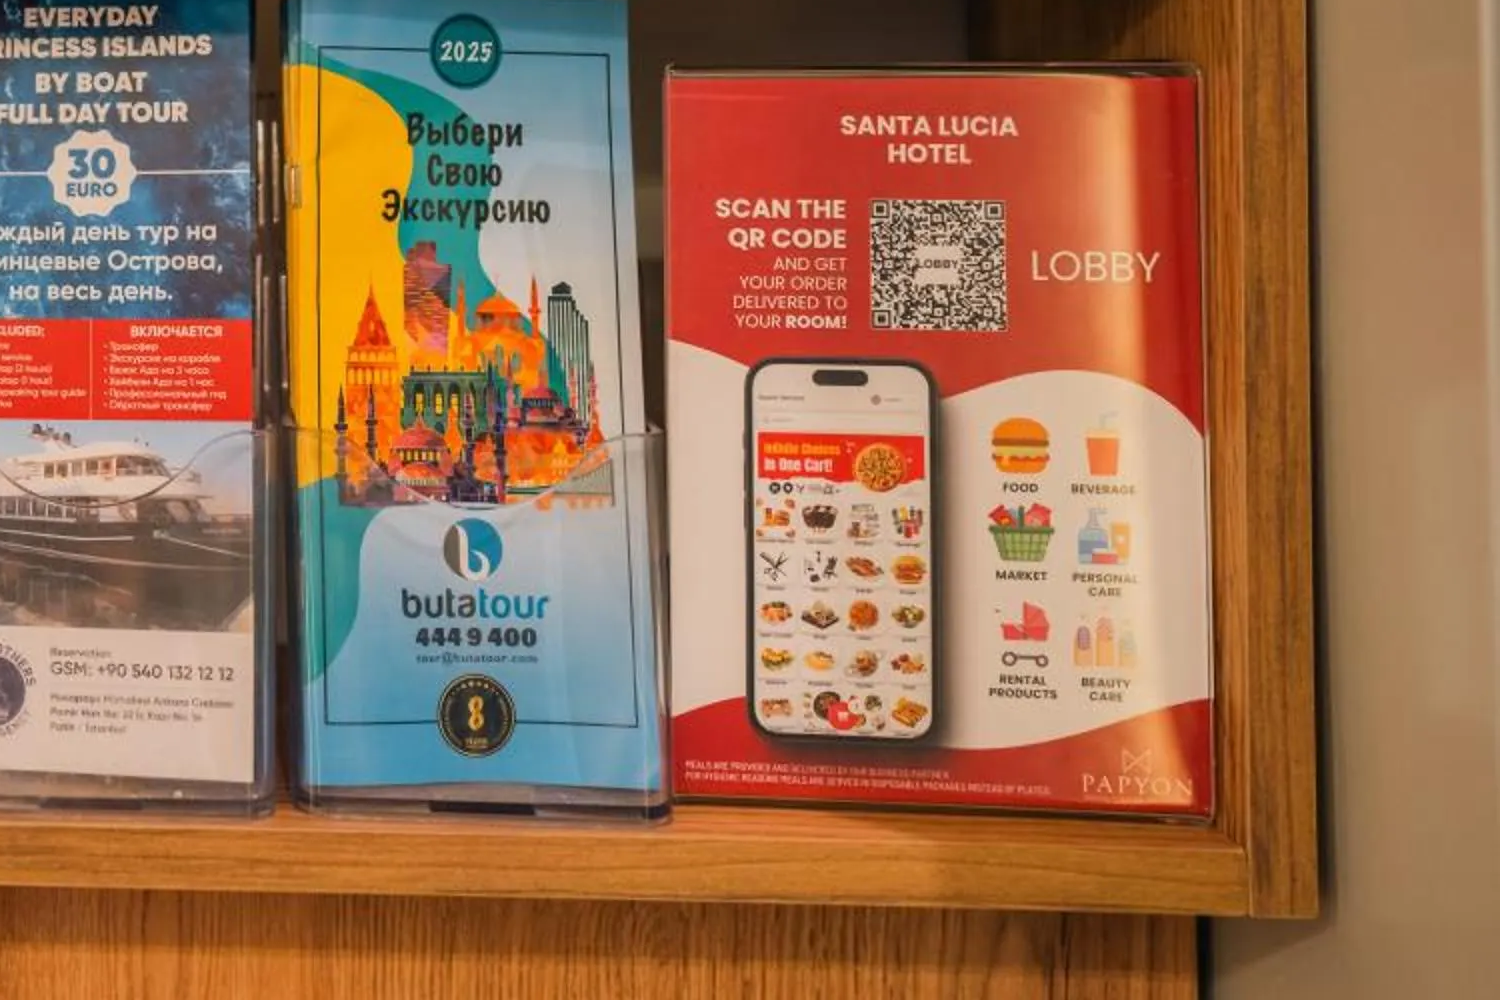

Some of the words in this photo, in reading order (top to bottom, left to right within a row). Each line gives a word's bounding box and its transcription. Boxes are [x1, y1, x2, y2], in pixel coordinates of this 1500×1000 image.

[23, 5, 158, 28] EVERYDAY
[102, 35, 213, 57] ISLANDS
[440, 41, 493, 63] 2025
[35, 72, 66, 94] BY
[77, 72, 148, 93] BOAT
[58, 103, 109, 124] DAY
[116, 101, 189, 123] TOUR
[407, 112, 524, 153] Выбери
[840, 115, 932, 137] SANTA
[938, 115, 1019, 138] LUCIA
[67, 147, 117, 180] 30
[887, 143, 972, 165] HOTEL
[426, 154, 502, 187] Свою
[66, 183, 118, 197] EURO
[381, 188, 551, 230] Экскурсию
[715, 198, 791, 220] SCAN
[797, 198, 847, 220] THE
[72, 225, 131, 244] день
[138, 224, 180, 245] тур
[186, 223, 218, 240] на
[727, 228, 766, 250] QR
[771, 228, 847, 250] CODE
[108, 251, 224, 276] Острова,
[774, 258, 810, 272] AND
[815, 258, 847, 272] GET
[1030, 251, 1161, 283] LOBBY
[9, 287, 39, 301] на
[47, 285, 102, 301] весь
[108, 284, 173, 303] день.
[739, 276, 786, 290] YOUR
[790, 276, 848, 291] ORDER
[733, 295, 819, 309] DELIVERED
[824, 296, 847, 310] TO
[130, 325, 224, 338] ВКЛЮЧАЕТСЯ
[735, 314, 781, 329] YOUR
[785, 315, 848, 329] ROOM!
[1003, 483, 1039, 494] FOOD
[1071, 484, 1136, 495] BEVERAGE
[995, 570, 1048, 581] MARKET
[1072, 573, 1137, 585] PERSONAL
[1088, 587, 1122, 597] CARE
[401, 588, 549, 620] butatour
[415, 628, 461, 647] 444
[466, 628, 483, 647] 9
[487, 628, 537, 648] 400
[50, 660, 94, 677] GSM:
[97, 663, 128, 679] +90
[131, 663, 163, 679] 540
[167, 665, 193, 681] 132
[198, 666, 214, 682] 12
[218, 666, 235, 682] 12
[999, 674, 1046, 686] RENTAL
[989, 687, 1057, 700] PRODUCTS
[1081, 677, 1131, 689] BEAUTY
[1089, 691, 1123, 702] CARE
[467, 694, 485, 731] 8
[1082, 774, 1193, 796] PAPYON
